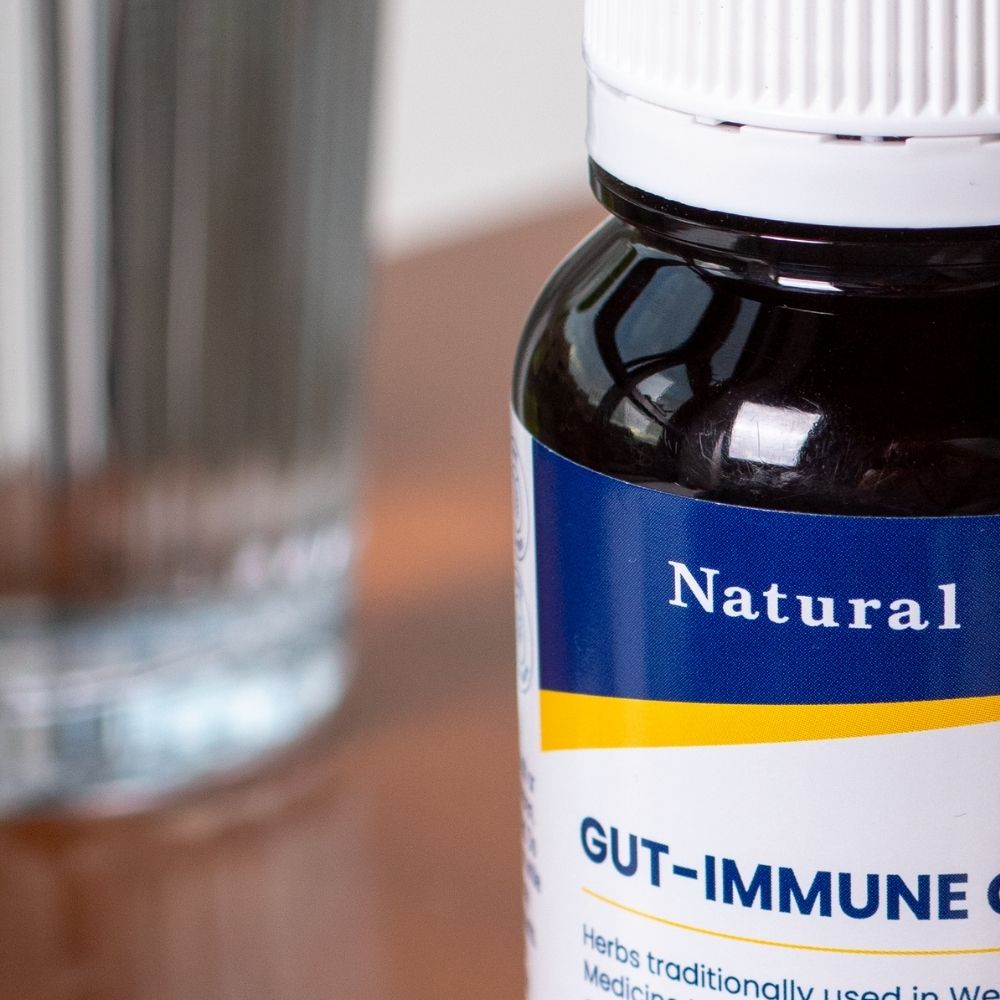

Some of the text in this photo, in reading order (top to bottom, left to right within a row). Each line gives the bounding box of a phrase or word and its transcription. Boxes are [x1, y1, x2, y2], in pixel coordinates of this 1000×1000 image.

[667, 560, 962, 632] Natural
[579, 815, 969, 921] GUT-IMMUNE
[582, 924, 641, 969] Herbs
